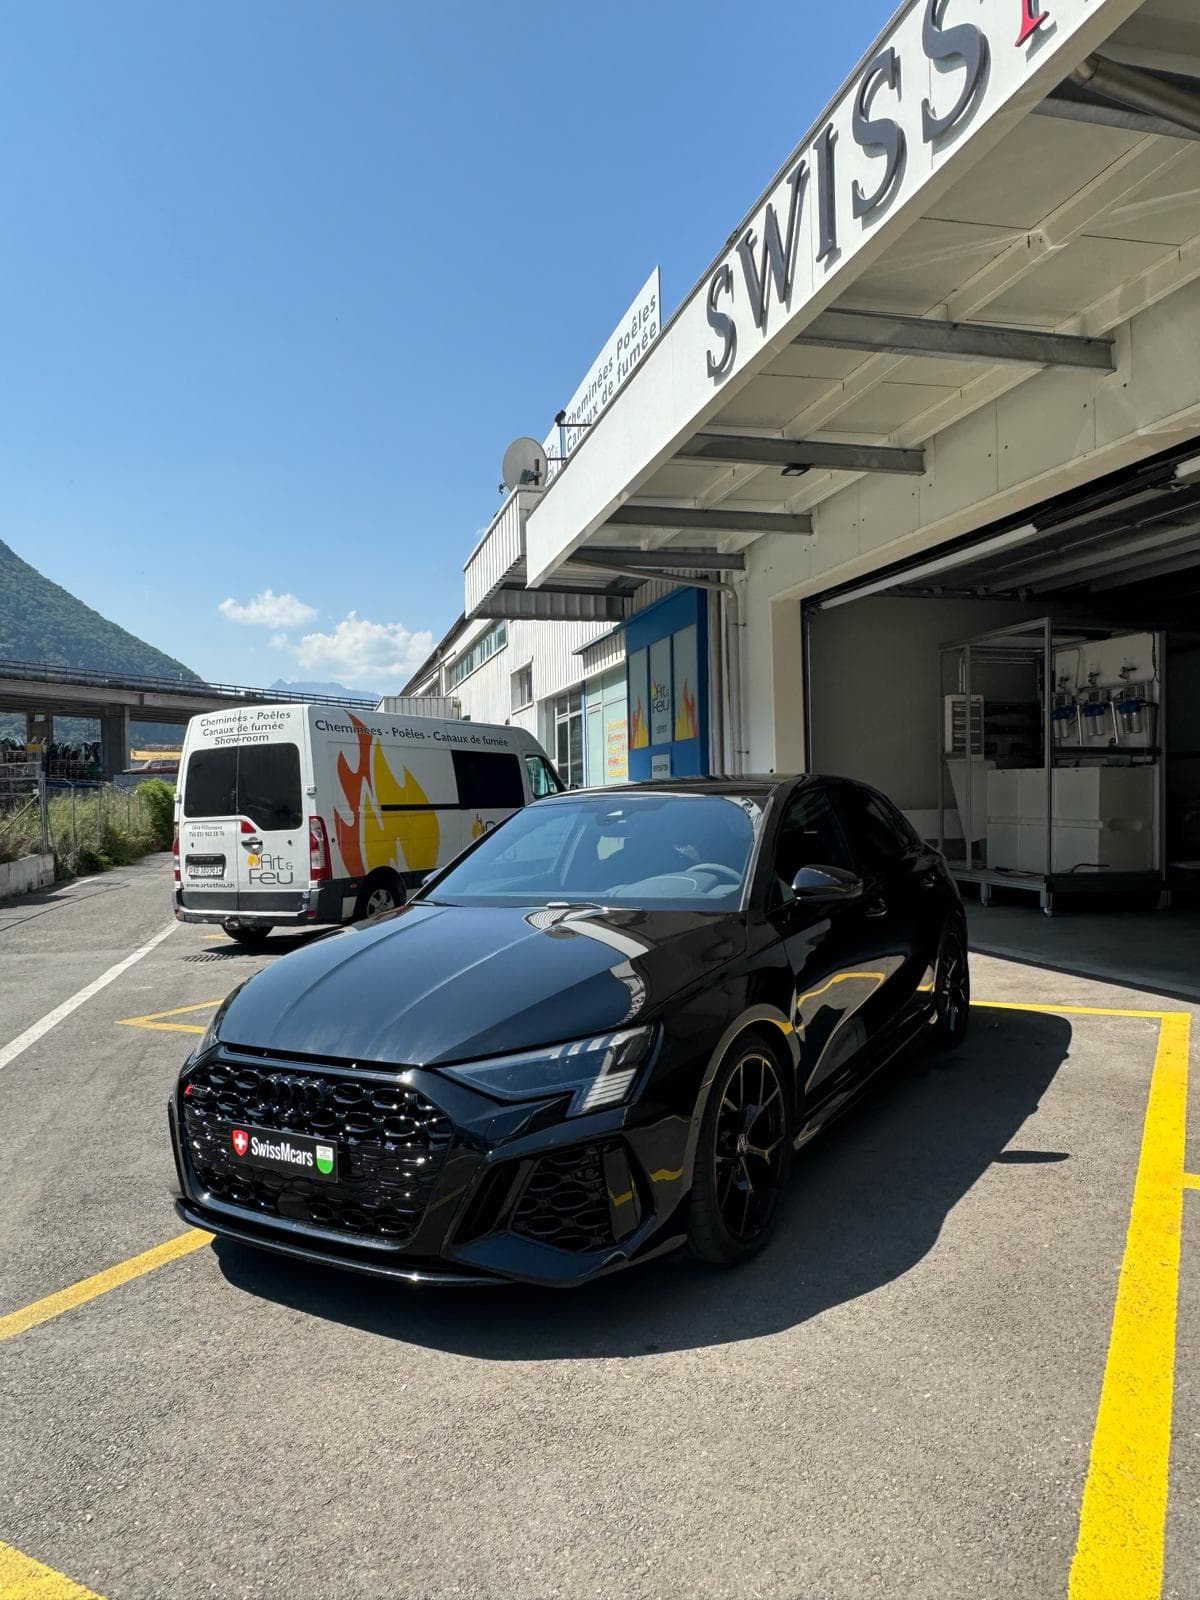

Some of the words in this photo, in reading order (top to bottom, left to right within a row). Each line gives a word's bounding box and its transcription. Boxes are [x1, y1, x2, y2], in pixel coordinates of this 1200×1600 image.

[566, 357, 613, 434] Cheminées
[616, 294, 656, 360] Poêles
[566, 401, 599, 453] Canaux
[601, 381, 614, 406] de
[617, 321, 657, 384] fumée
[200, 715, 248, 727] Cheminées
[257, 711, 291, 720] Poêles
[203, 727, 234, 736] Canaux
[237, 724, 248, 732] de
[251, 721, 284, 731] fumée
[315, 719, 382, 736] Cheminées
[392, 727, 425, 740] Poêles
[433, 731, 468, 744] Canaux
[470, 735, 481, 744] de
[261, 853, 285, 870] Art
[248, 868, 294, 885] Feu
[251, 1137, 314, 1167] SwissMcars
